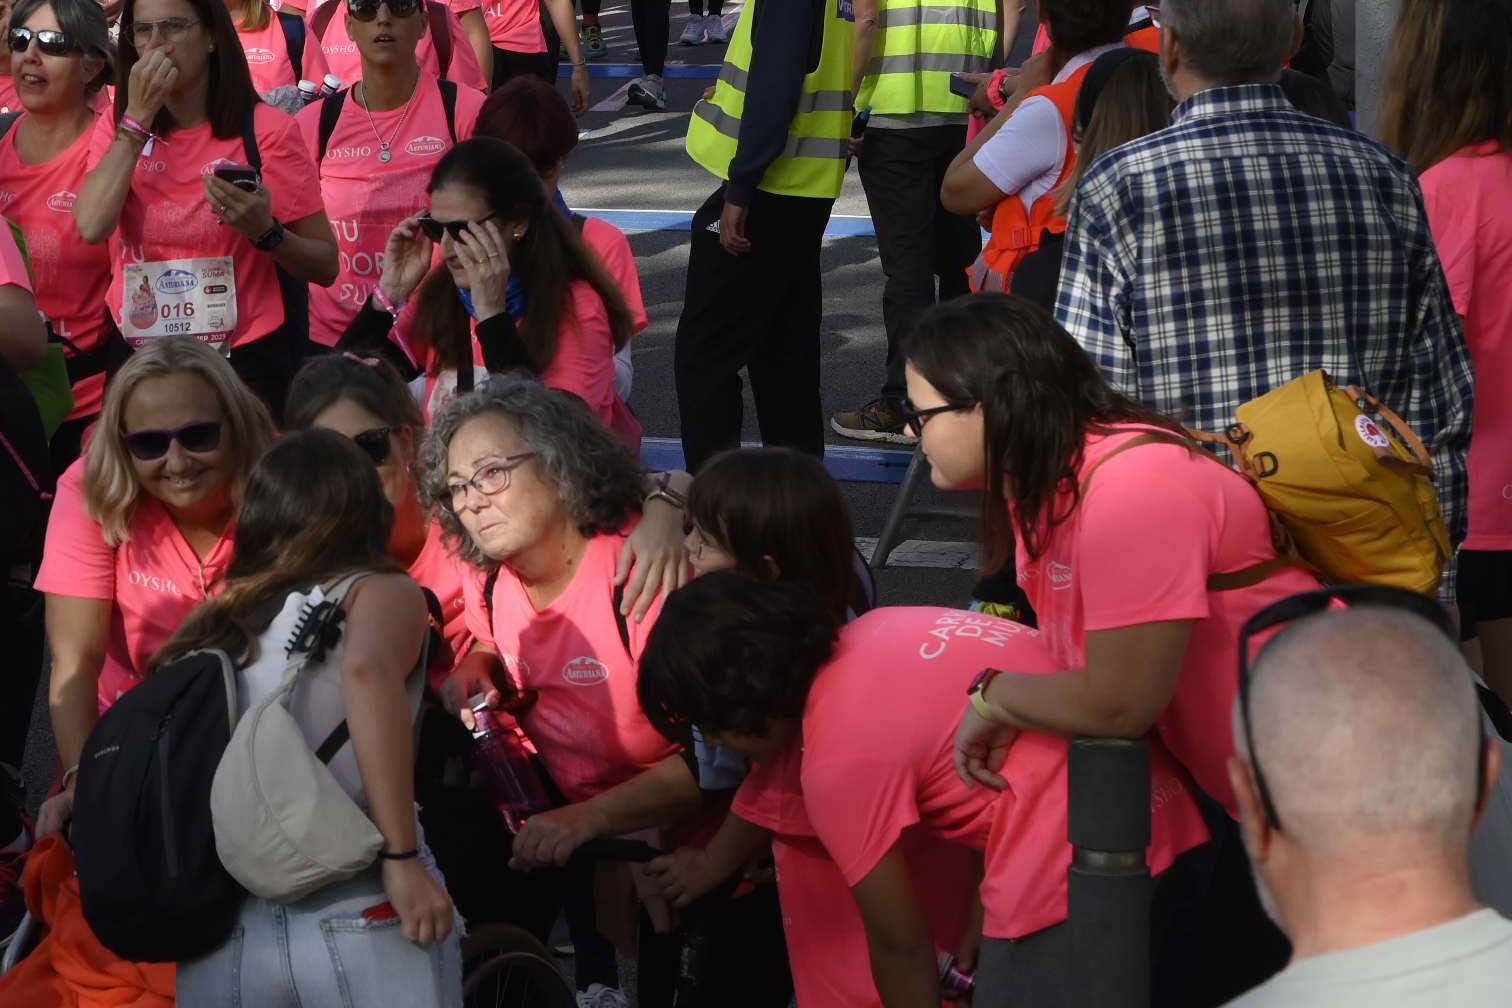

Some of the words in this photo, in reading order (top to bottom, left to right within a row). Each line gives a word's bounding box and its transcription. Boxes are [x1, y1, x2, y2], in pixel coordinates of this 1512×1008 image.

[326, 145, 372, 160] OYSHO
[160, 302, 195, 319] 016
[164, 322, 192, 333] 10512
